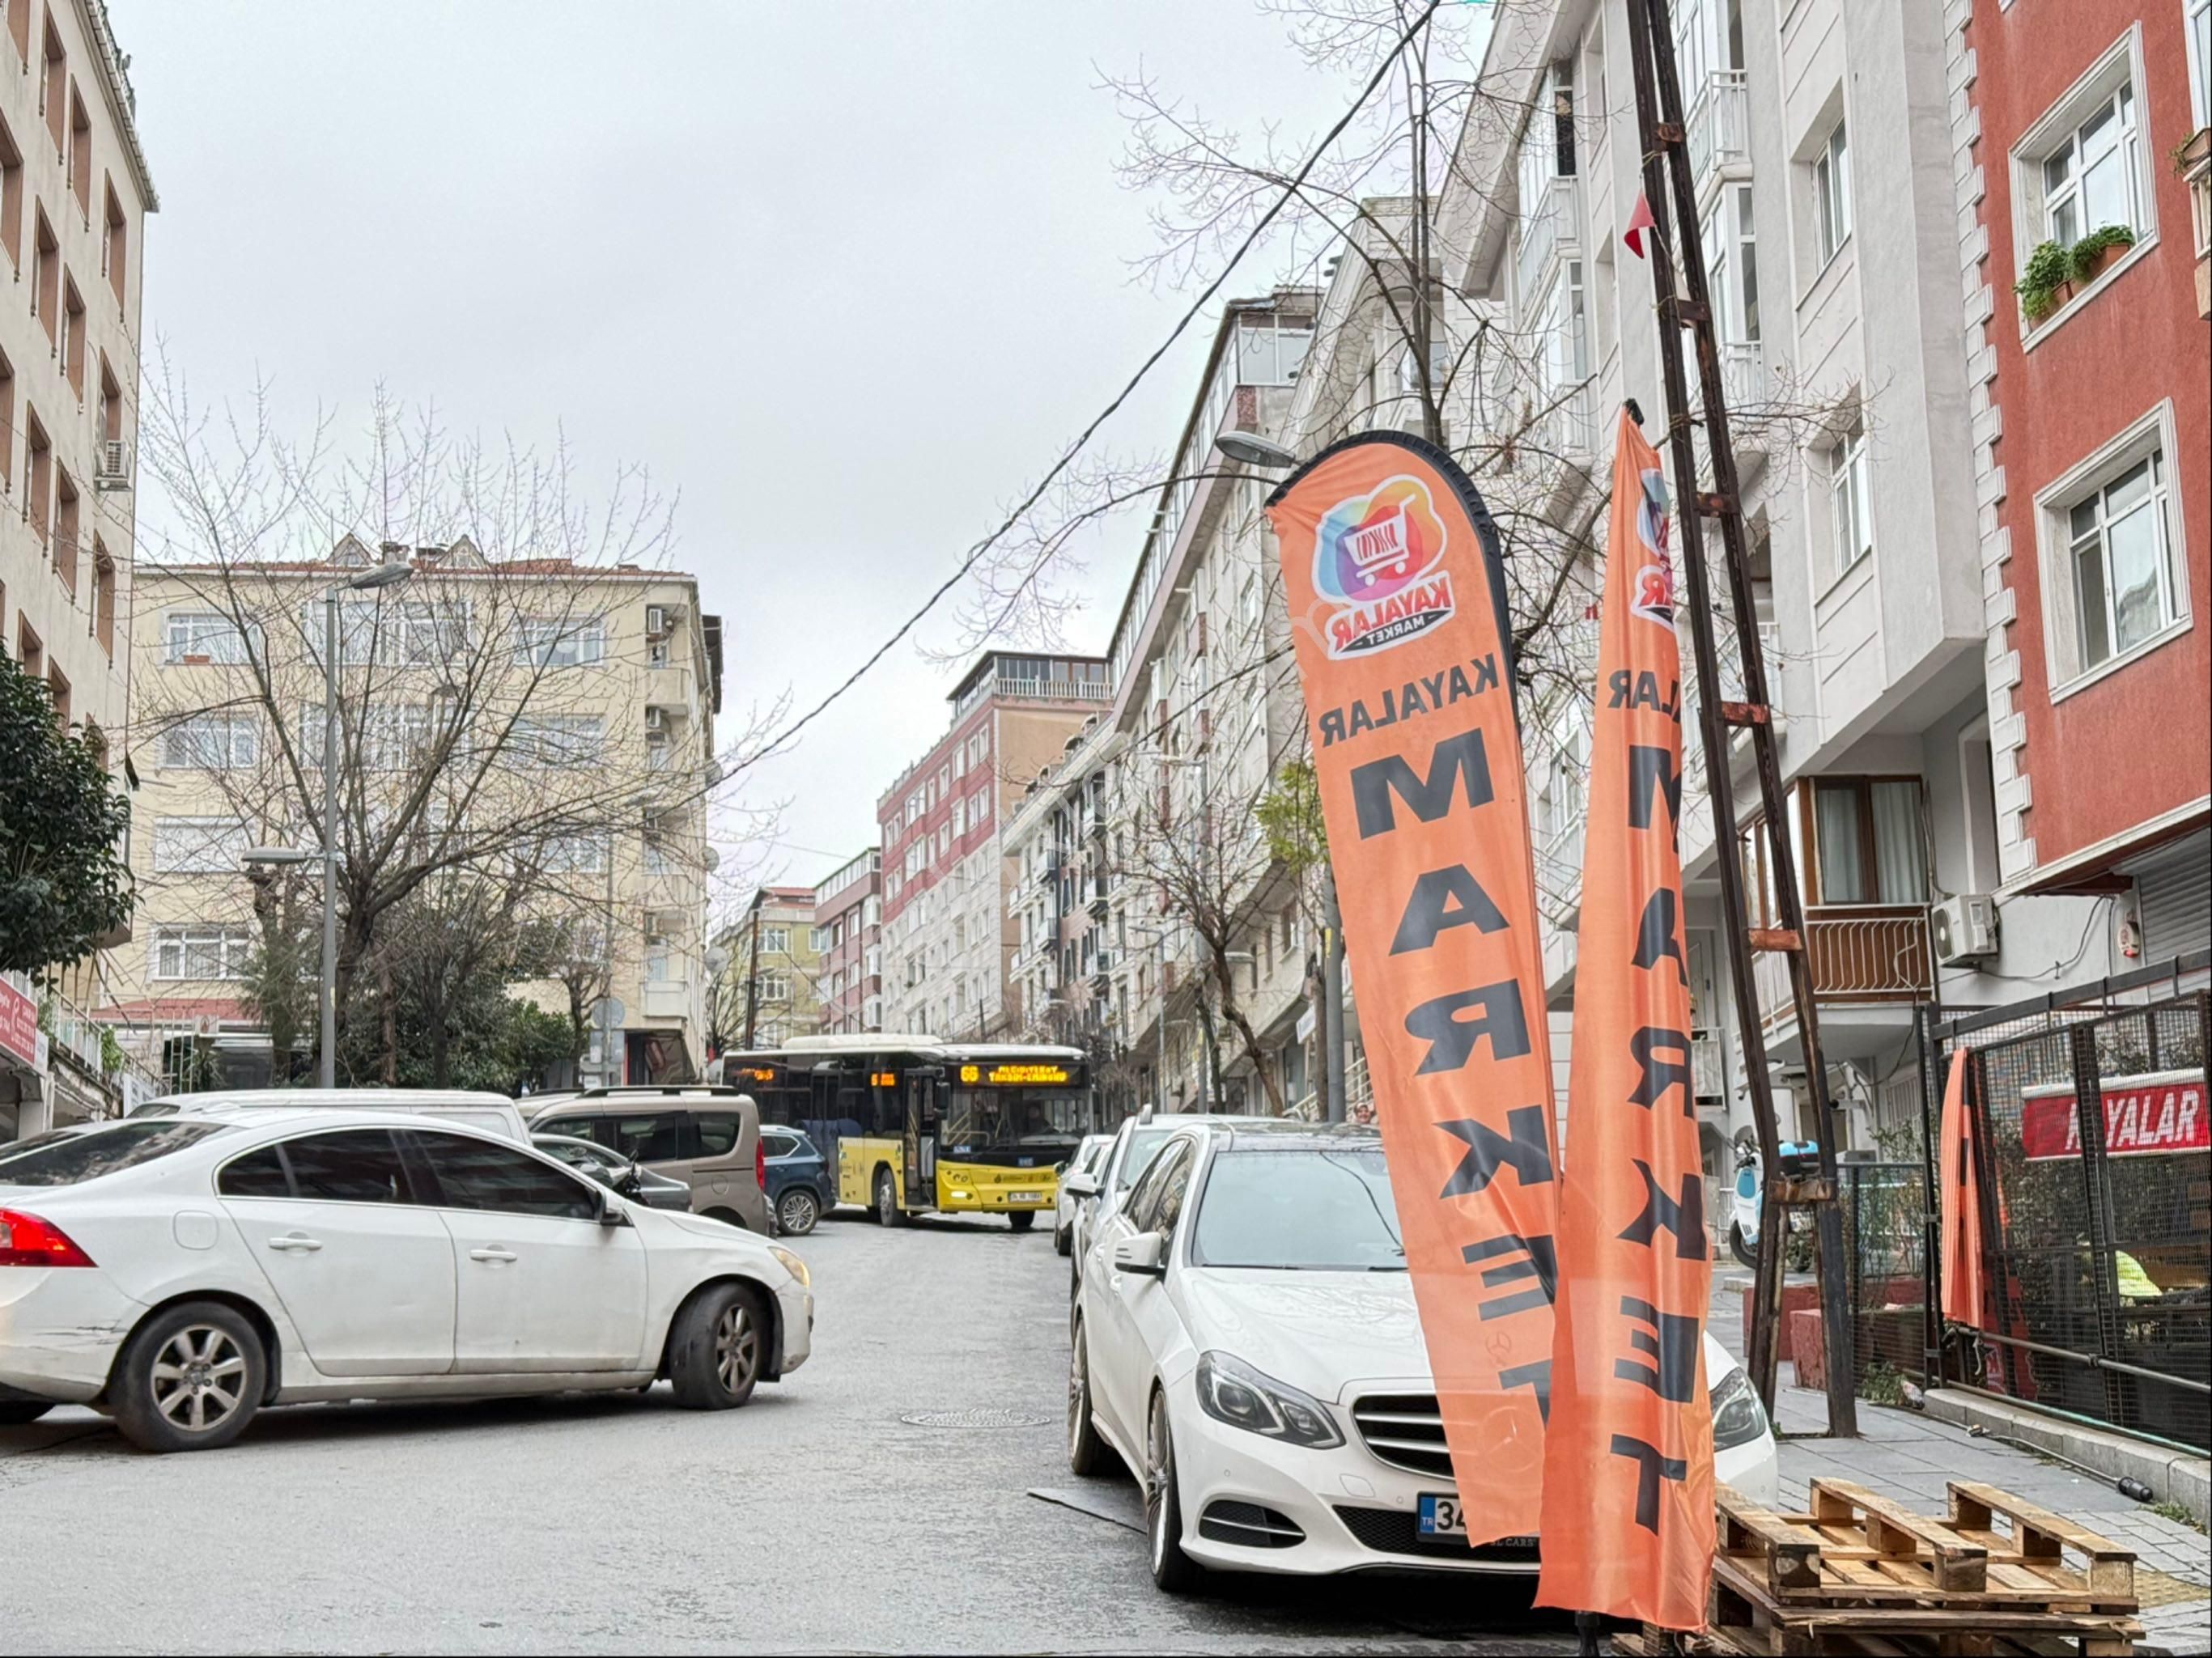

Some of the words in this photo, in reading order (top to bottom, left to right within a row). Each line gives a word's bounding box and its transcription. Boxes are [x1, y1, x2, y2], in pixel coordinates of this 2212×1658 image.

[961, 1065, 979, 1082] 66
[2066, 1090, 2199, 1150] KYALAR
[1421, 1517, 1433, 1526] TR
[1505, 1538, 1534, 1547] CARS
